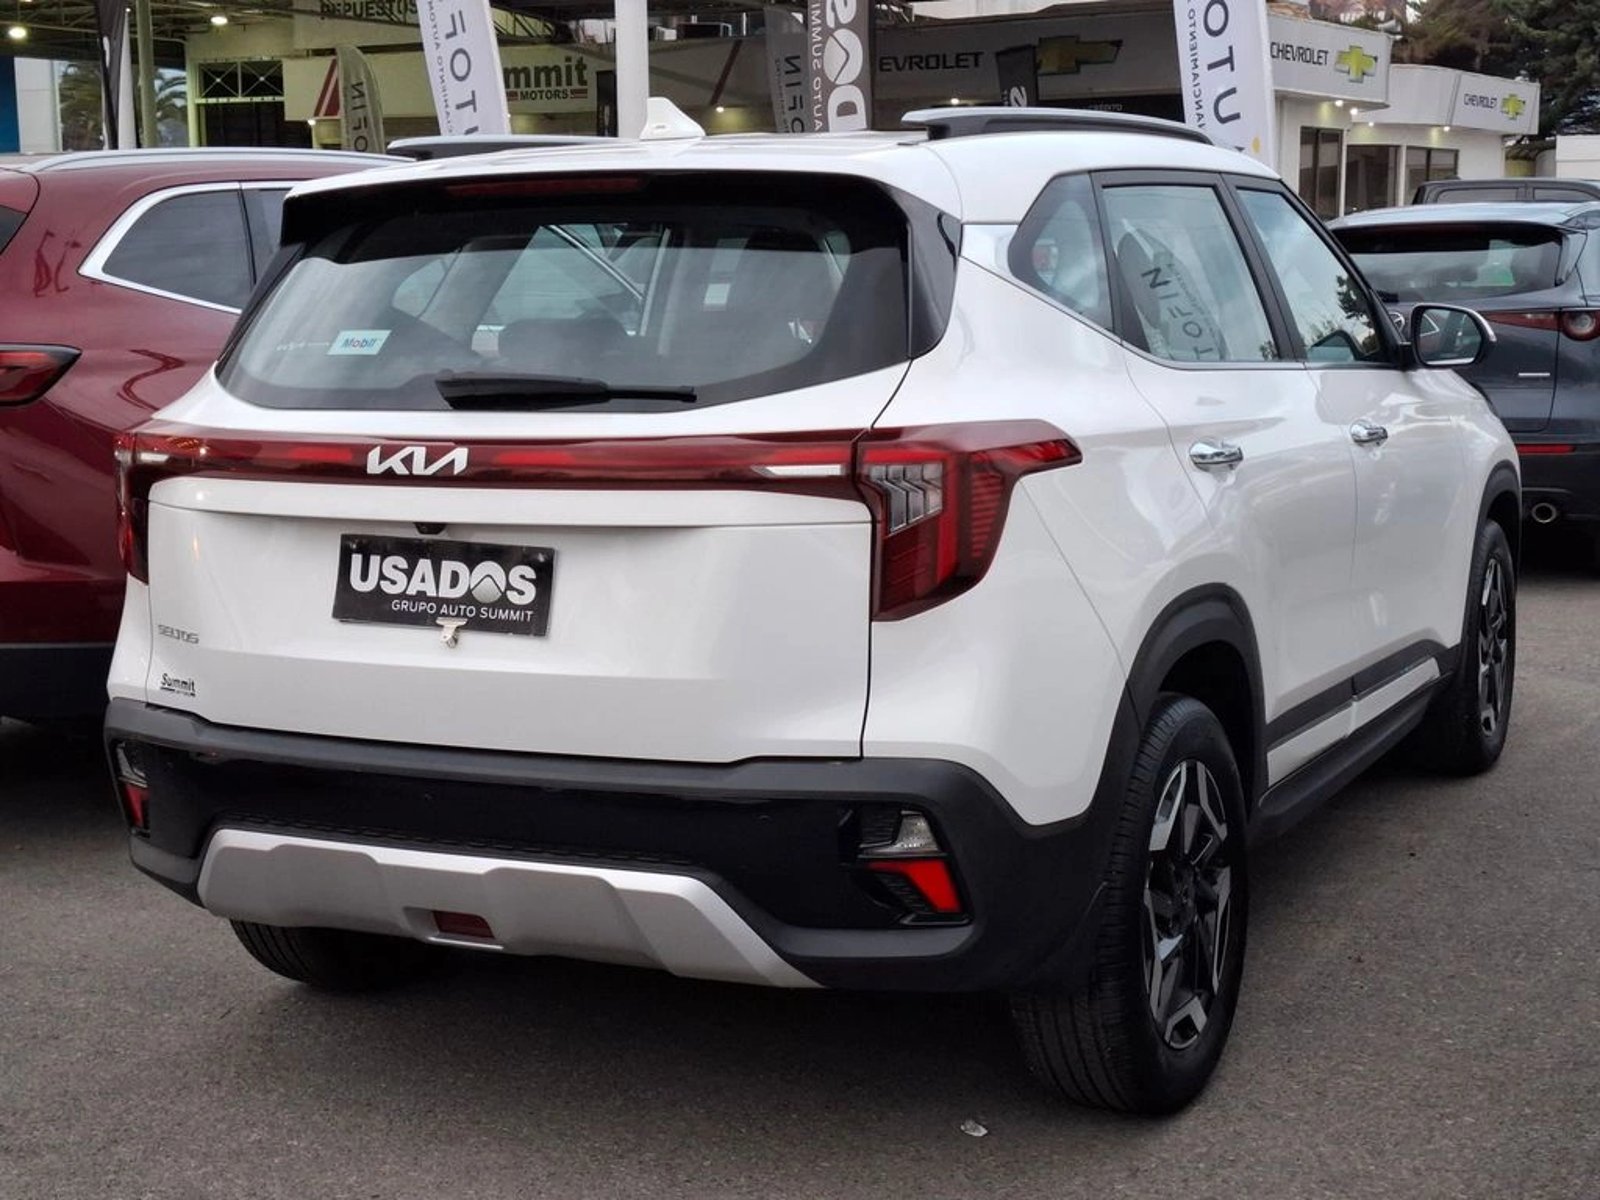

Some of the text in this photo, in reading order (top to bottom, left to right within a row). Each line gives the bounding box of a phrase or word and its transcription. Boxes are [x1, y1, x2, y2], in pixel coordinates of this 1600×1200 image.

[879, 51, 985, 73] EVROLET
[1270, 41, 1329, 66] CHEVROLET
[519, 88, 569, 101] MOTORS
[367, 445, 468, 476] KIA
[349, 553, 537, 606] USADOS
[391, 599, 534, 622] GRUPO AUTO SUMMIT
